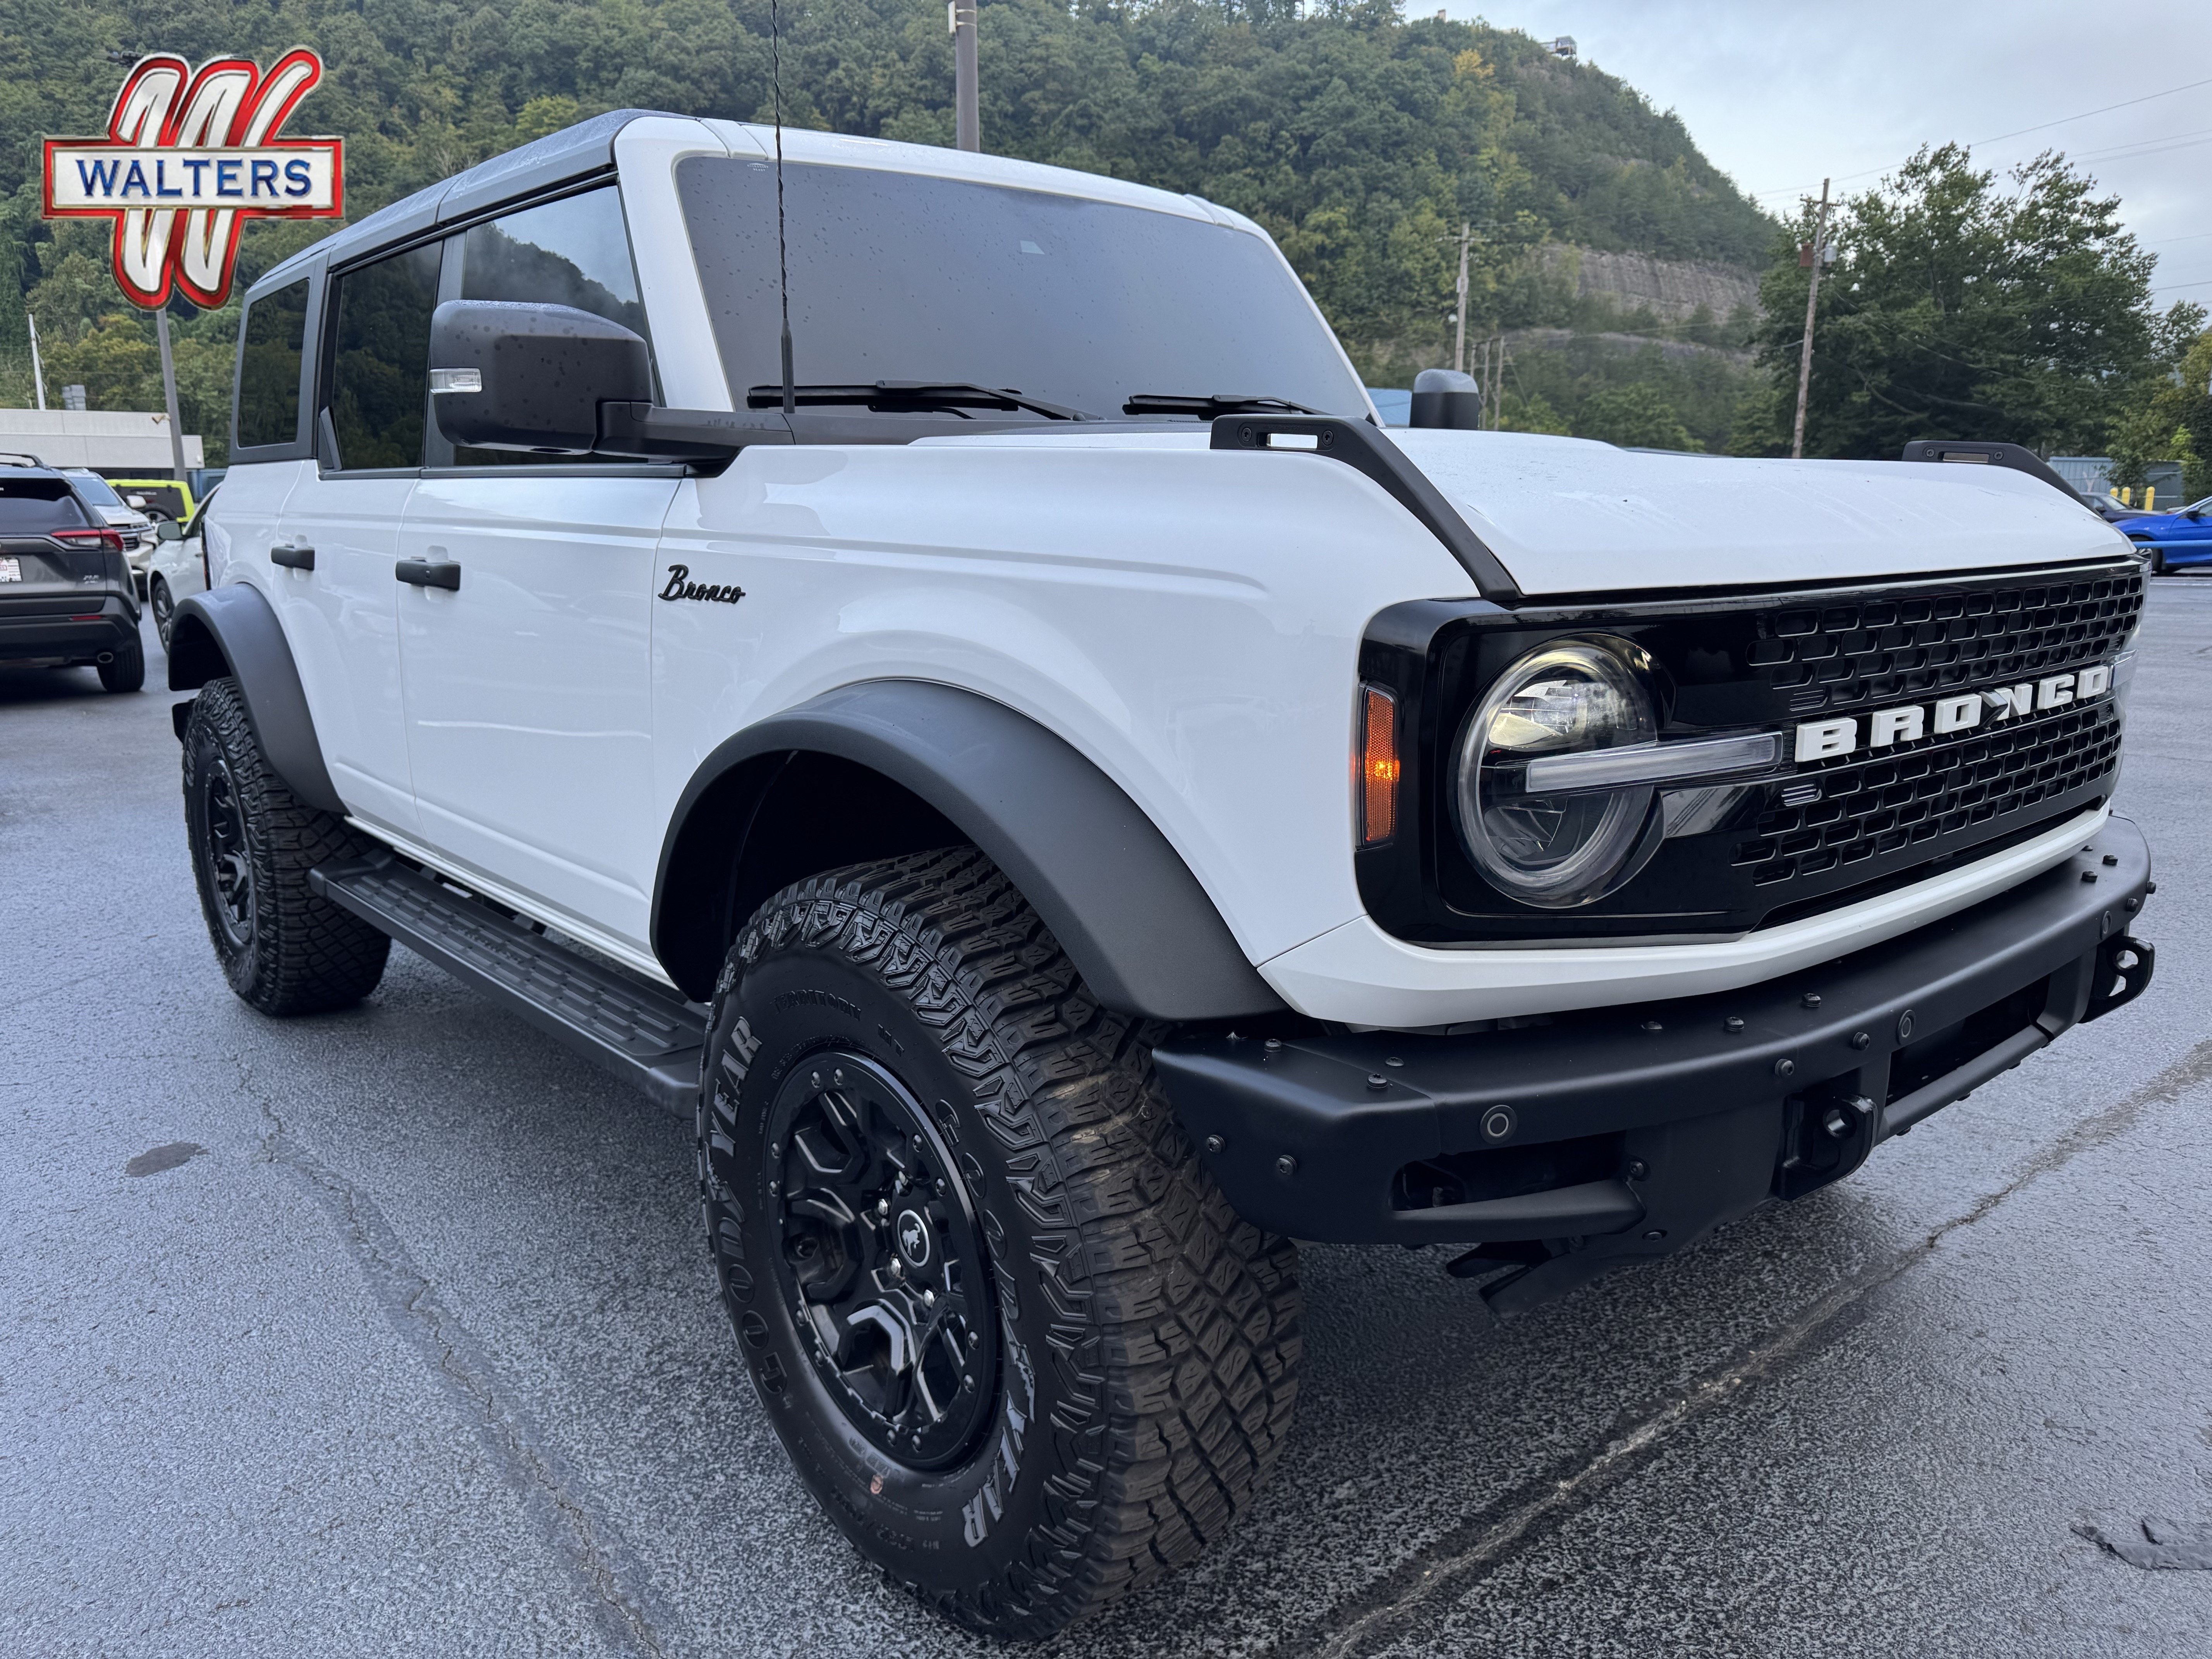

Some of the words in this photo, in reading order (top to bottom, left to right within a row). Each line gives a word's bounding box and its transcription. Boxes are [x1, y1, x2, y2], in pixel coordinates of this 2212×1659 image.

[658, 564, 746, 604] Bronco
[1795, 665, 2109, 763] BRONCO
[769, 989, 862, 1021] TERRITORY
